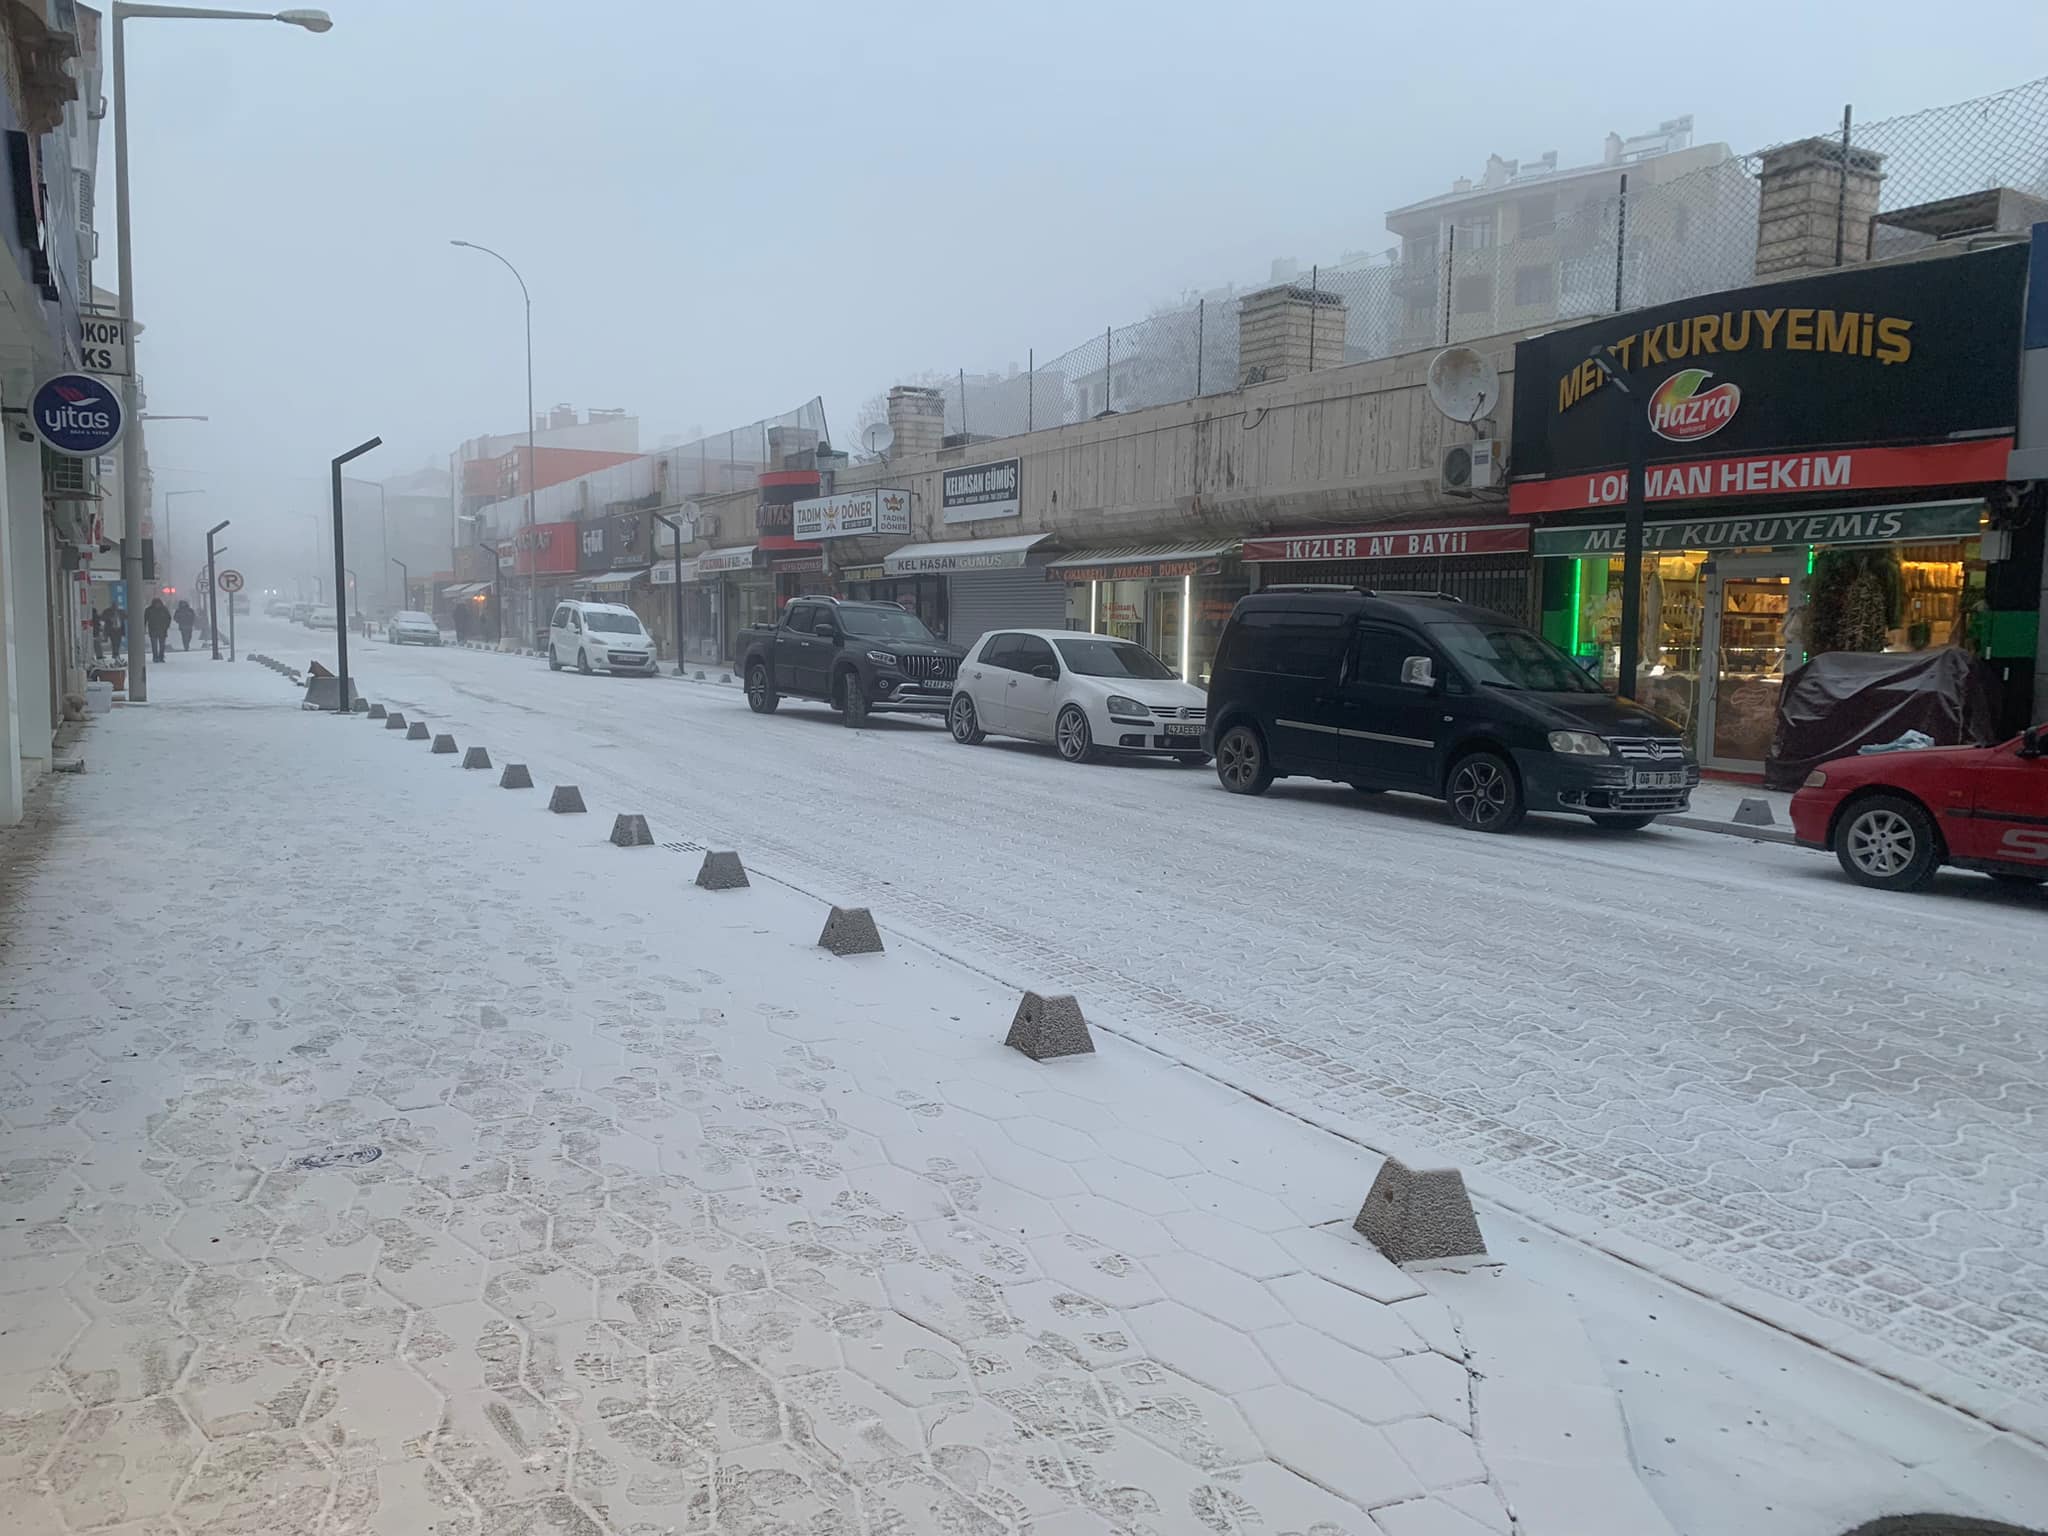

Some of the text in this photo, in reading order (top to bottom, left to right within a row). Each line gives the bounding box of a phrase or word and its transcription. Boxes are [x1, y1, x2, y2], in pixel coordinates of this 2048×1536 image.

[1652, 395, 1732, 431] Hazra
[841, 500, 872, 520] DÖNER
[1369, 536, 1394, 556] AV
[898, 559, 917, 571] KEL
[920, 557, 956, 570] HASAN
